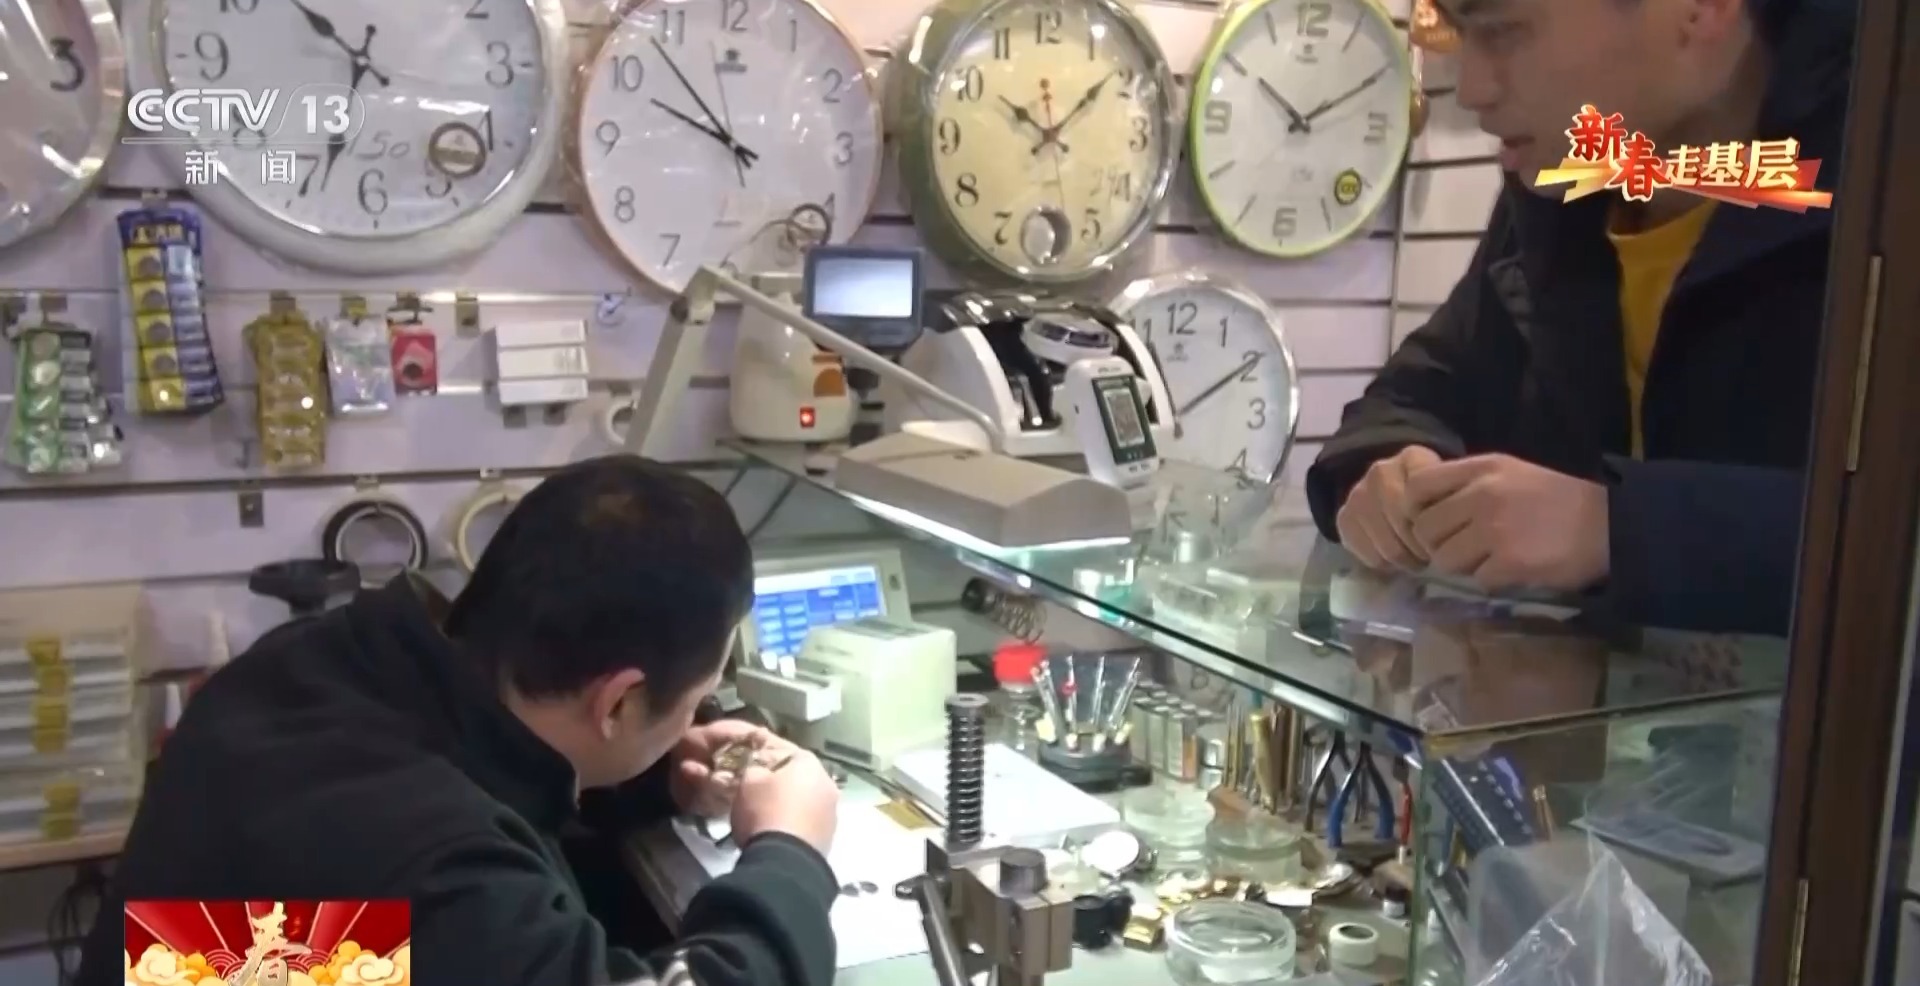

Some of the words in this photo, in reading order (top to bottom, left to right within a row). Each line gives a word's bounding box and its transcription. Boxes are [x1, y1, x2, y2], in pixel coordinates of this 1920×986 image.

[660, 9, 685, 45] 11
[721, 0, 748, 31] 12
[1035, 11, 1062, 44] 12
[1296, 3, 1332, 38] 12
[195, 32, 229, 82] 9
[994, 27, 1011, 60] 11
[49, 37, 85, 92] 3
[485, 40, 514, 88] 3
[612, 54, 644, 92] 10
[822, 67, 843, 103] 2
[1129, 116, 1148, 151] 3
[1204, 100, 1232, 134] 9
[1364, 112, 1388, 143] 3
[595, 120, 620, 156] 9
[833, 131, 854, 165] 3
[939, 117, 961, 155] 9
[358, 169, 389, 215] 6
[614, 186, 635, 223] 8
[955, 172, 979, 208] 8
[994, 211, 1012, 245] 7
[1081, 207, 1101, 242] 5
[1272, 207, 1297, 237] 6
[659, 233, 681, 267] 7
[1167, 302, 1197, 335] 12
[1219, 317, 1229, 348] 1
[1247, 400, 1266, 430] 3
